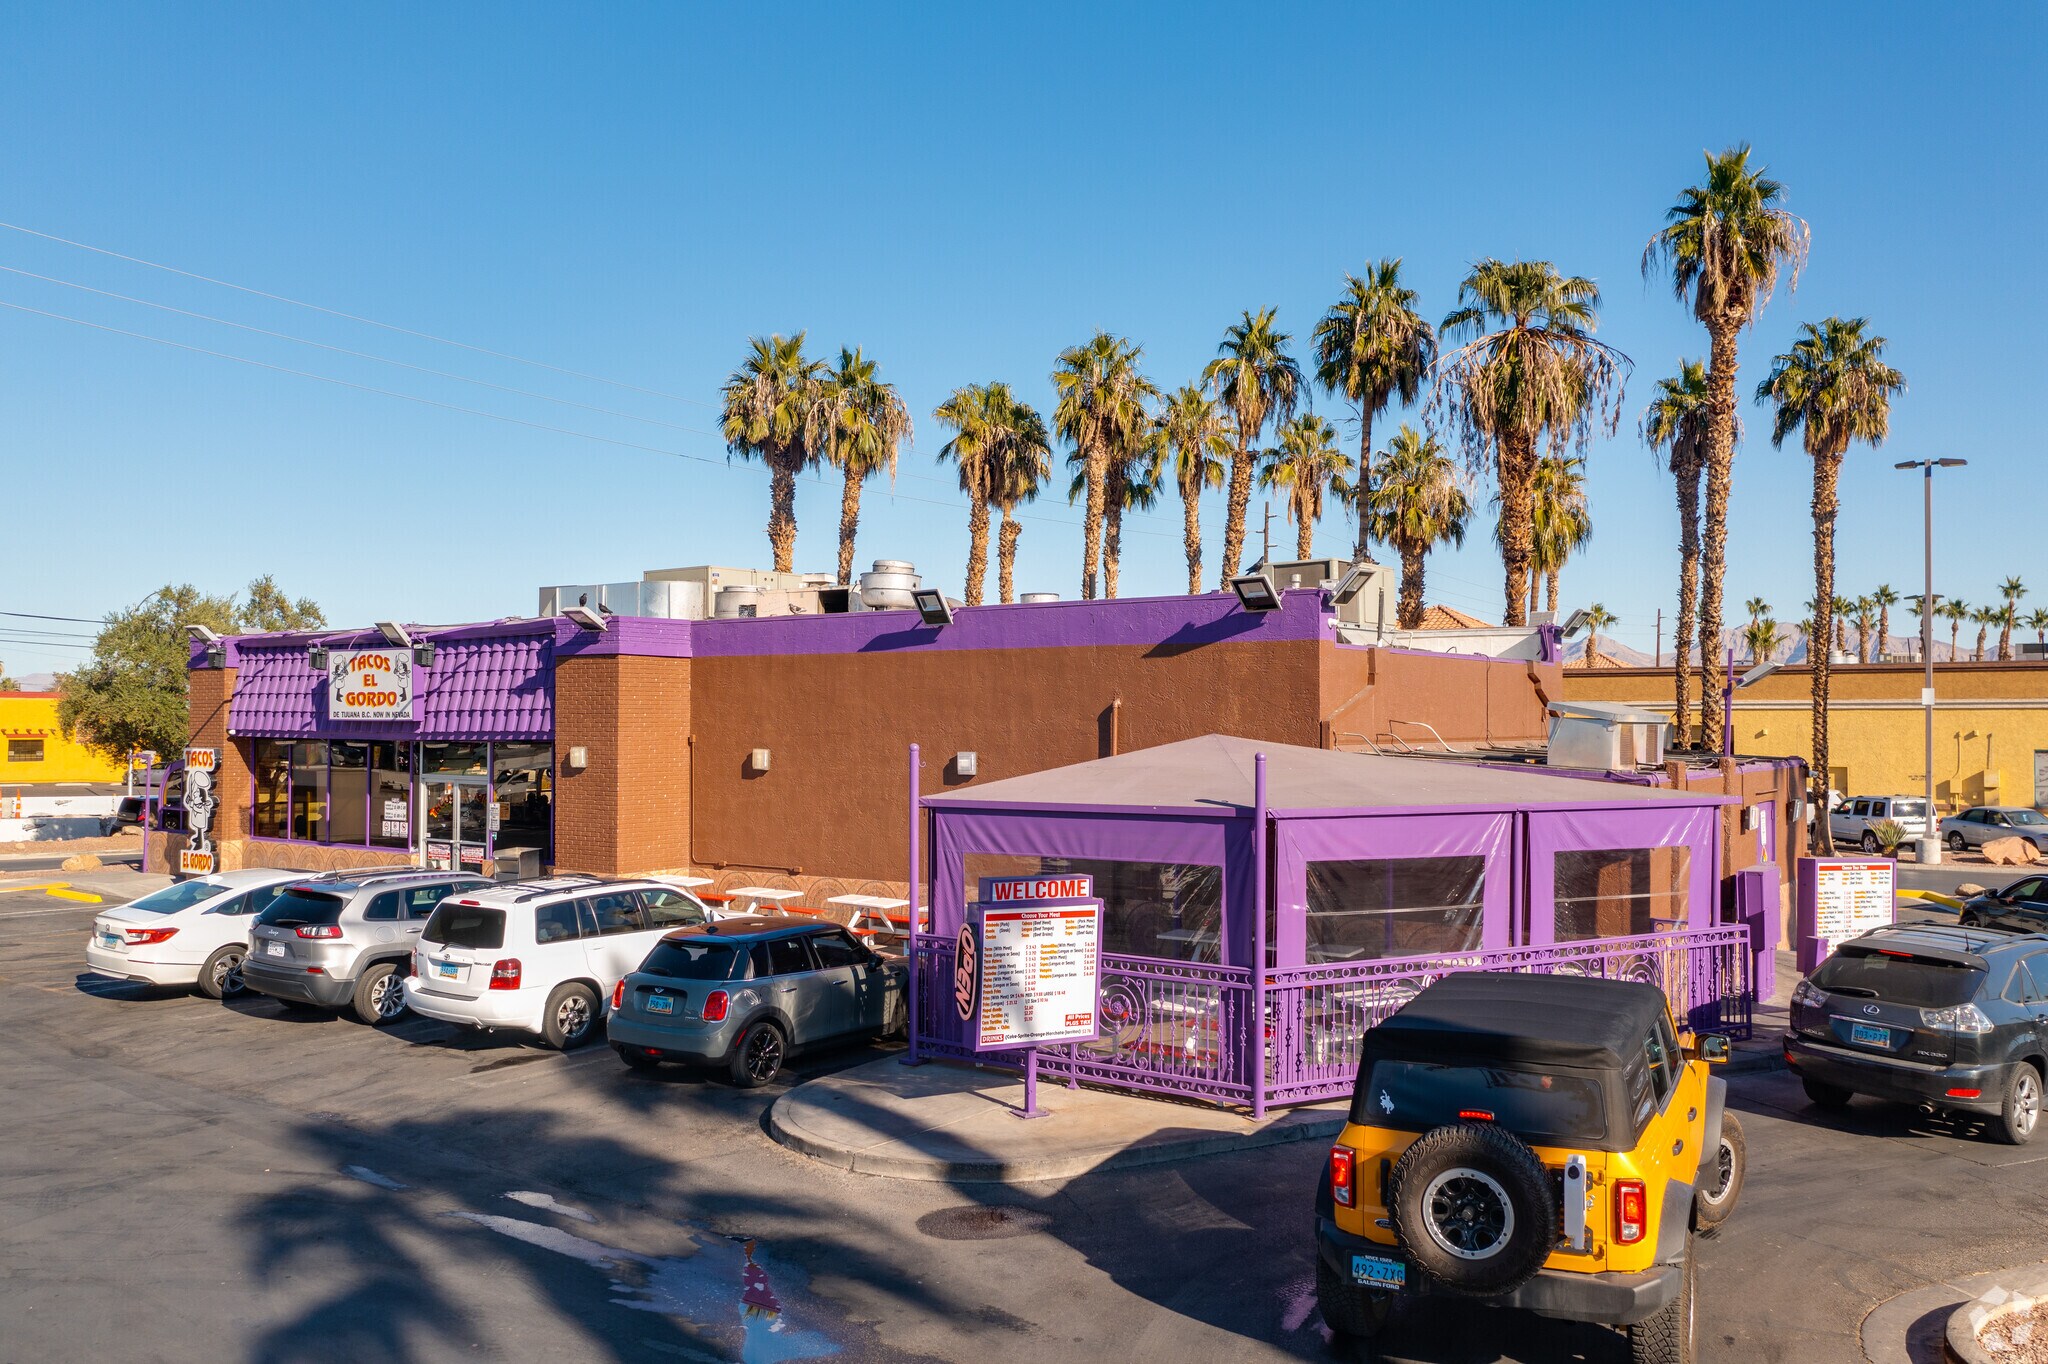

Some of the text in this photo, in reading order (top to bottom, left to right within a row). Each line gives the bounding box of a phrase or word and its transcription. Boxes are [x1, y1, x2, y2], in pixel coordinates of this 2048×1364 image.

[350, 654, 391, 673] TACOS
[363, 674, 378, 687] EL
[346, 692, 397, 708] GORDO
[185, 750, 214, 768] TACOS
[182, 852, 212, 872] EL GORDO
[995, 880, 1087, 900] WELCOME
[956, 929, 975, 1012] OPEN
[1804, 1028, 1825, 1036] LEXUS
